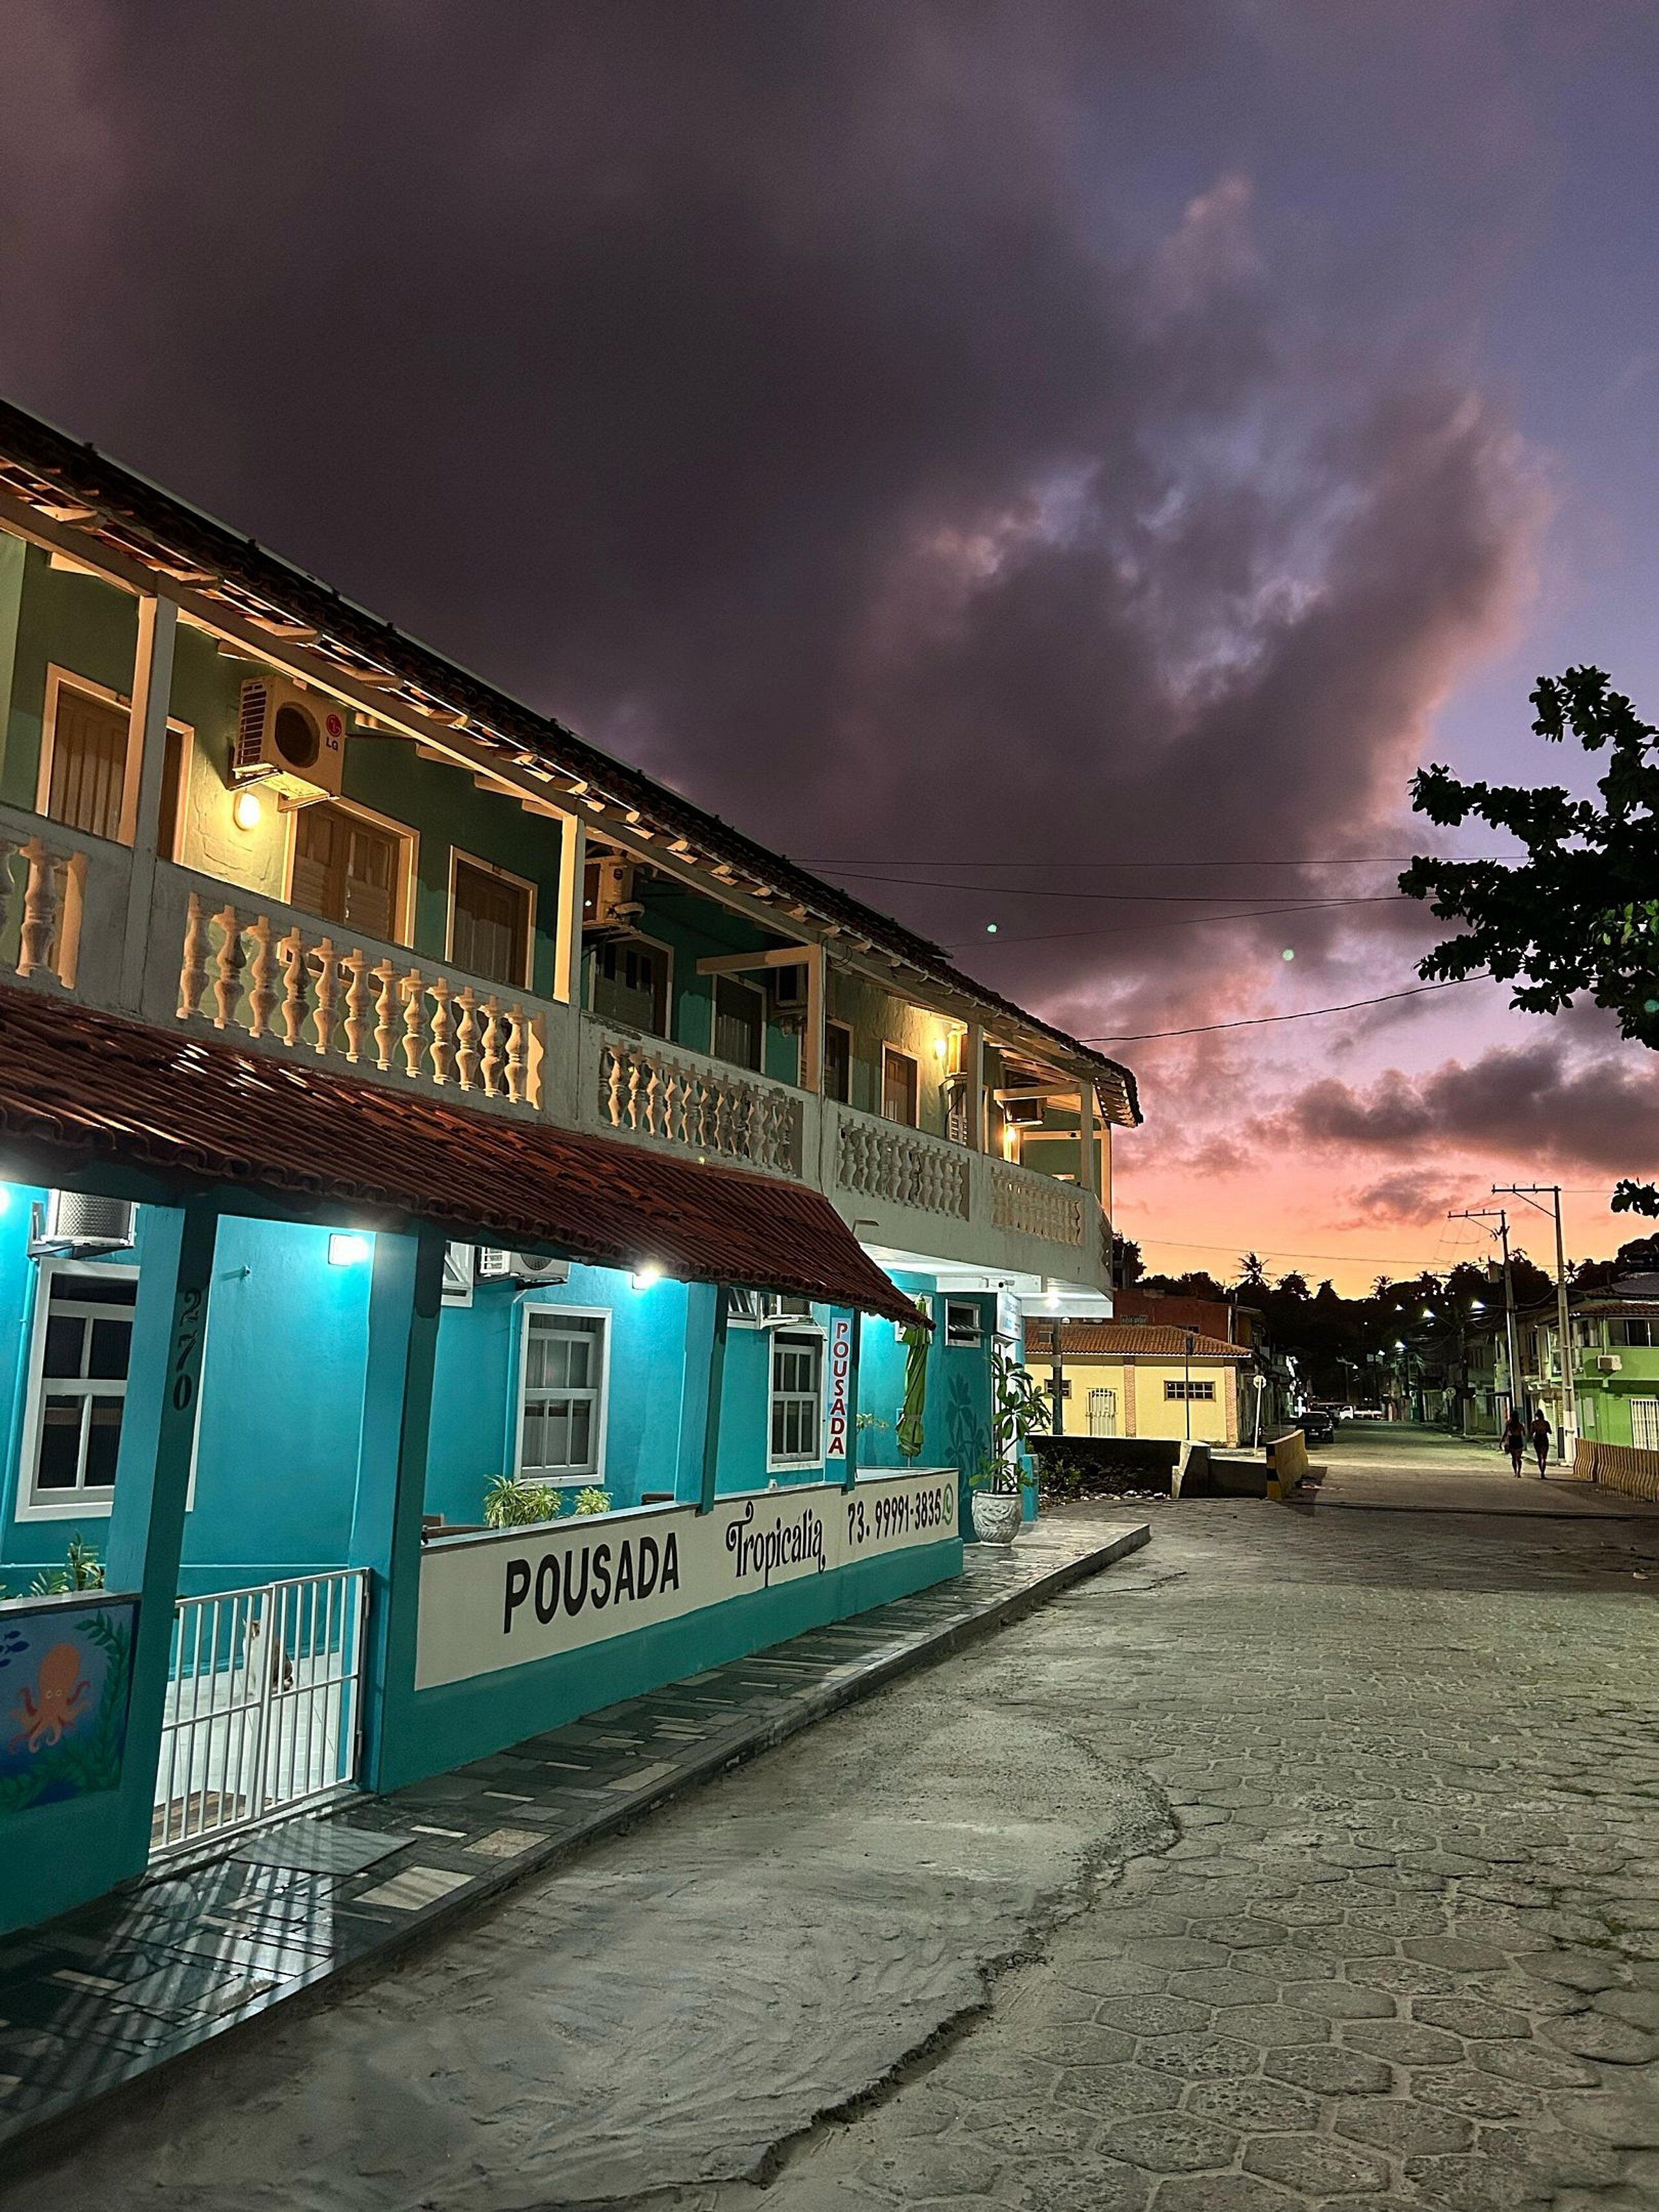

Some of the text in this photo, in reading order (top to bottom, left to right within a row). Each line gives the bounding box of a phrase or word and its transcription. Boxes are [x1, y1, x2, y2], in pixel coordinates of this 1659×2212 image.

[325, 737, 339, 752] LG
[172, 1288, 202, 1411] 270
[828, 1323, 849, 1454] POUSADA
[504, 1488, 941, 1635] POUSADA Tropicália 73. 99991-3835
